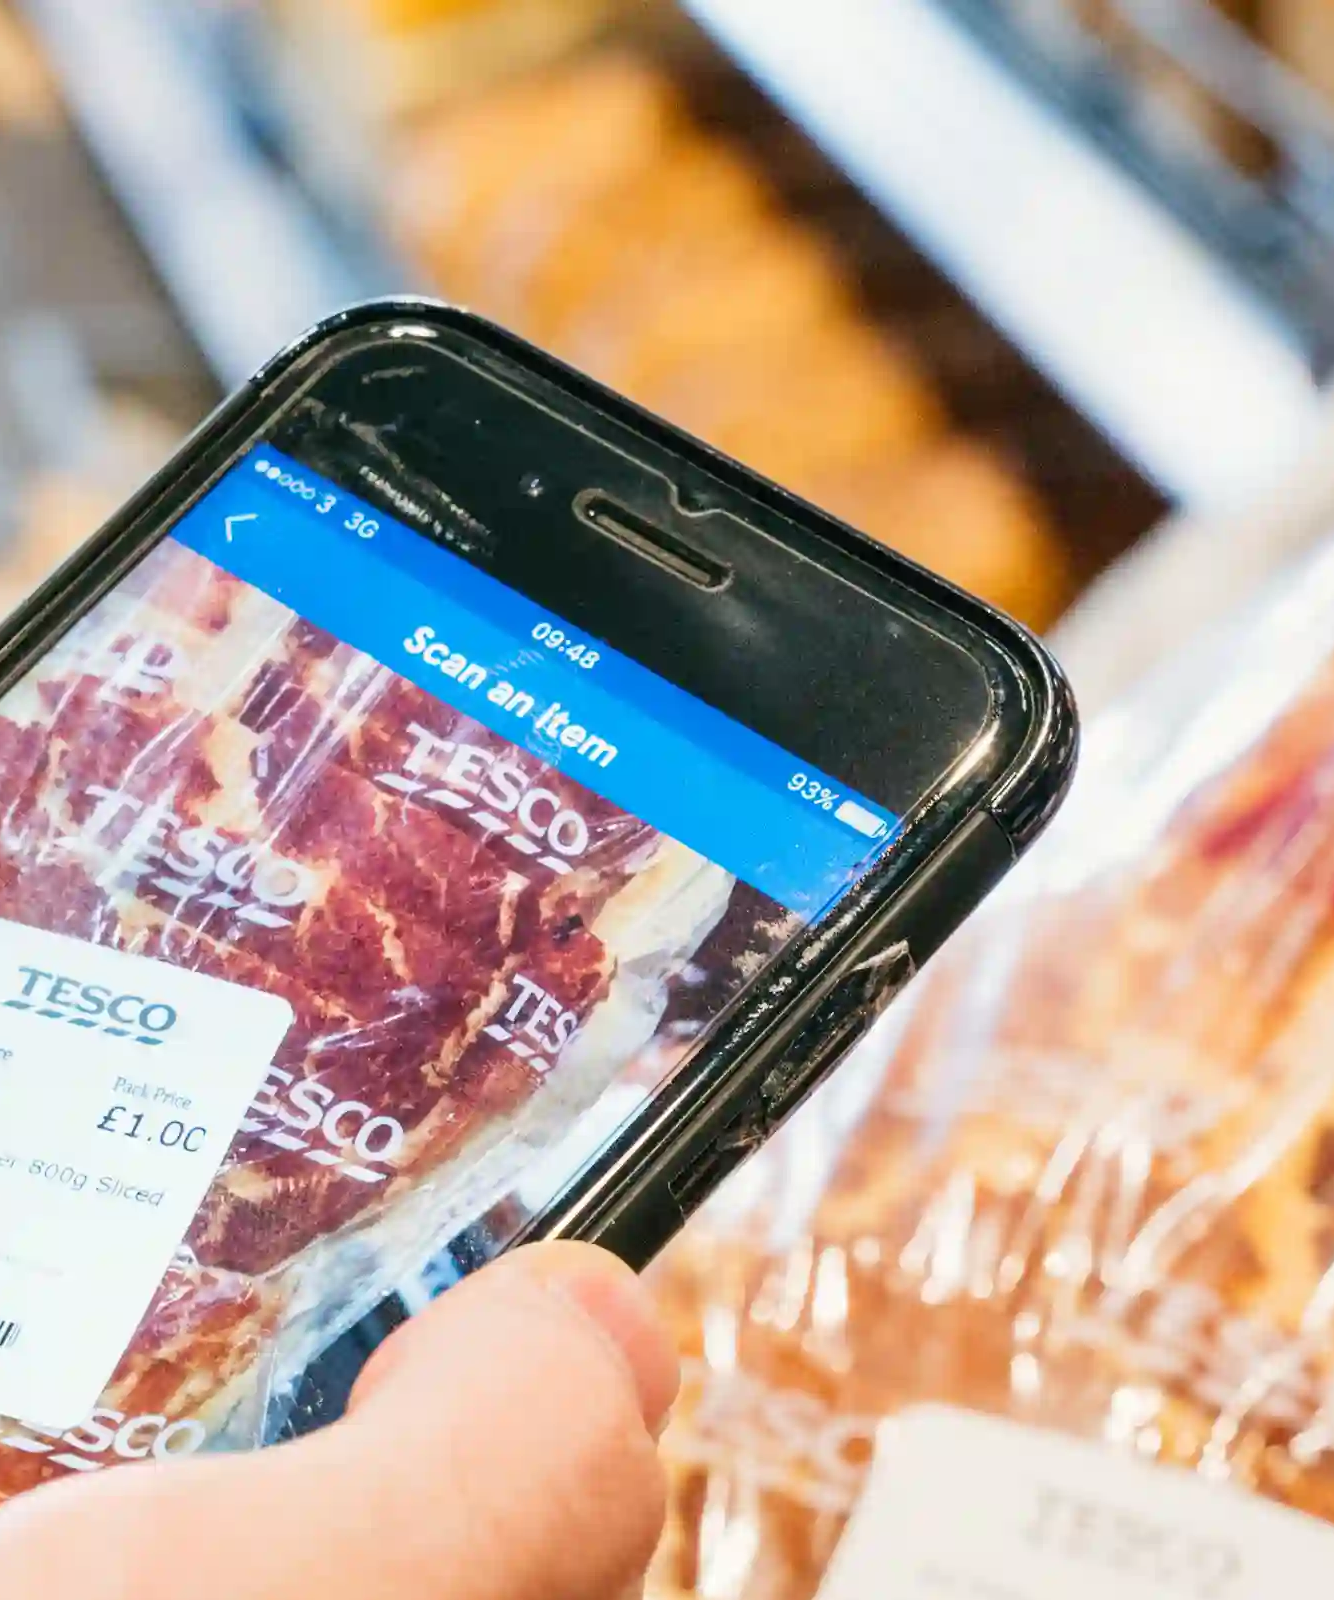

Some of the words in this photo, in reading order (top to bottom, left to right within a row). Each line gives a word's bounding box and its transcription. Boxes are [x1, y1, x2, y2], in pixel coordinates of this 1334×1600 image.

[343, 511, 380, 539] 3G
[531, 622, 601, 670] 09:48
[403, 625, 488, 690] Scan
[487, 680, 535, 718] an
[405, 722, 589, 857] TESCO
[787, 772, 840, 811] 93%
[17, 965, 178, 1034] TESCO
[152, 1086, 193, 1110] Price
[27, 1159, 88, 1191] 800g
[95, 1175, 165, 1208] Sliced
